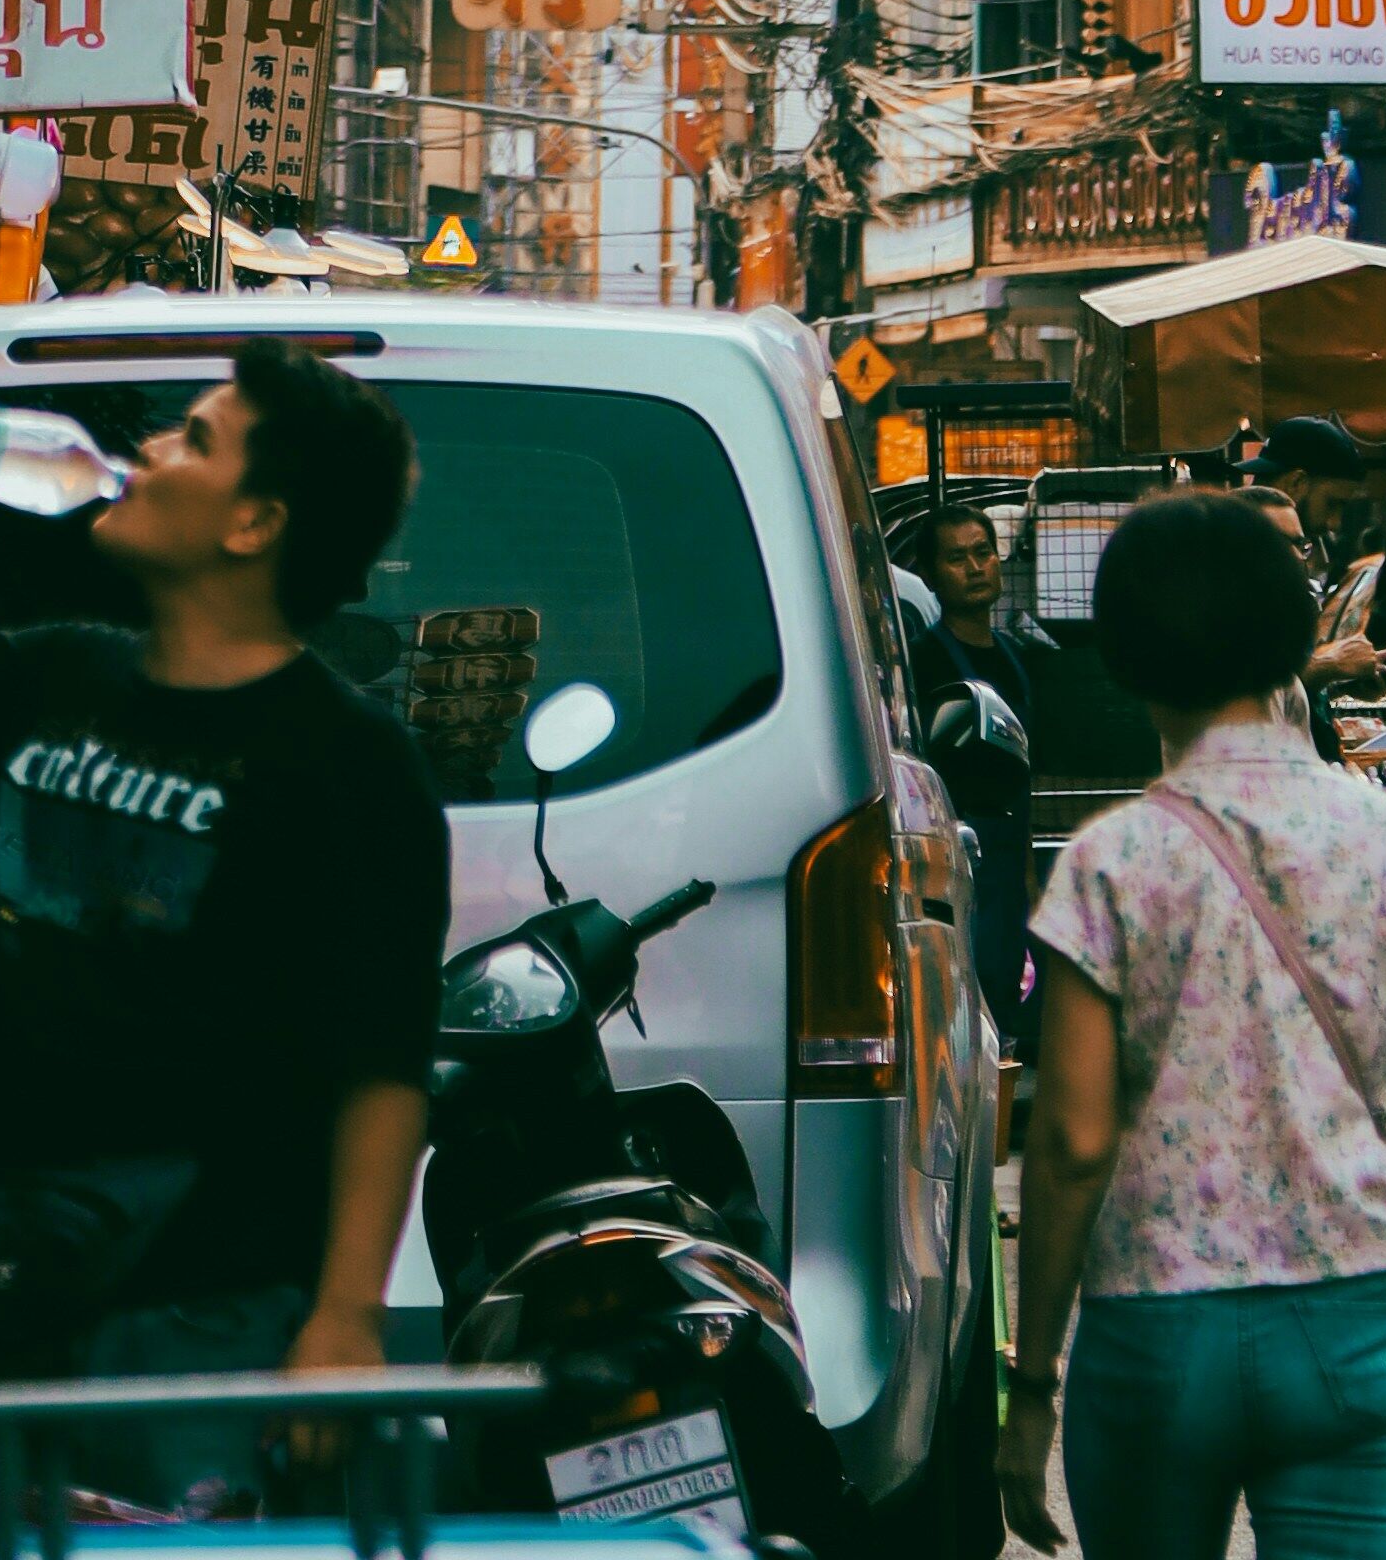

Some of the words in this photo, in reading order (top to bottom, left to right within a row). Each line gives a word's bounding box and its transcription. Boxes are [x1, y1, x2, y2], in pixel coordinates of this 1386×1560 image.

[1223, 46, 1263, 65] HUA
[1269, 46, 1322, 66] SENG
[1330, 47, 1385, 67] HONG
[7, 736, 225, 833] culture
